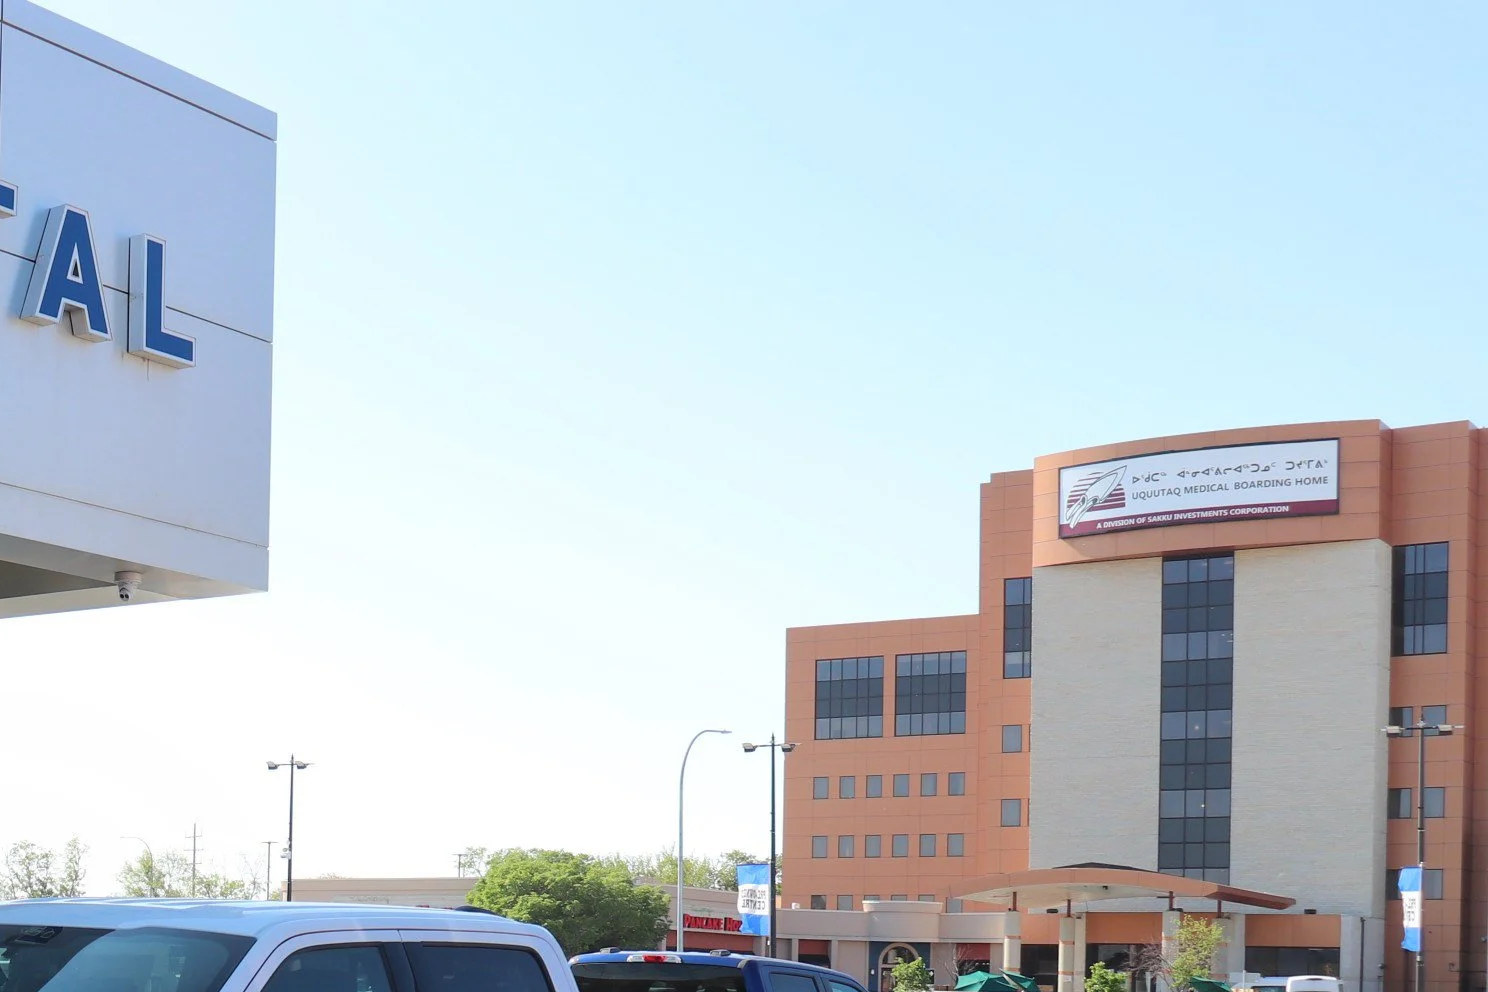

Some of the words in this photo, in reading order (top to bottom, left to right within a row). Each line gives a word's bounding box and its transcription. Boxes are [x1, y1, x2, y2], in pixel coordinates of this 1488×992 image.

[1131, 487, 1182, 501] UQUUTAQ
[1183, 483, 1230, 495] MEDICAL
[1234, 478, 1292, 491] BOARDING
[1295, 476, 1329, 486] HOME
[1096, 522, 1103, 530] A
[1103, 518, 1136, 529] DIVISION
[1136, 517, 1146, 525] OF
[1147, 514, 1173, 523] SAKKU
[1173, 508, 1229, 521] INVESTMENTS
[1229, 505, 1289, 516] CORPORATION
